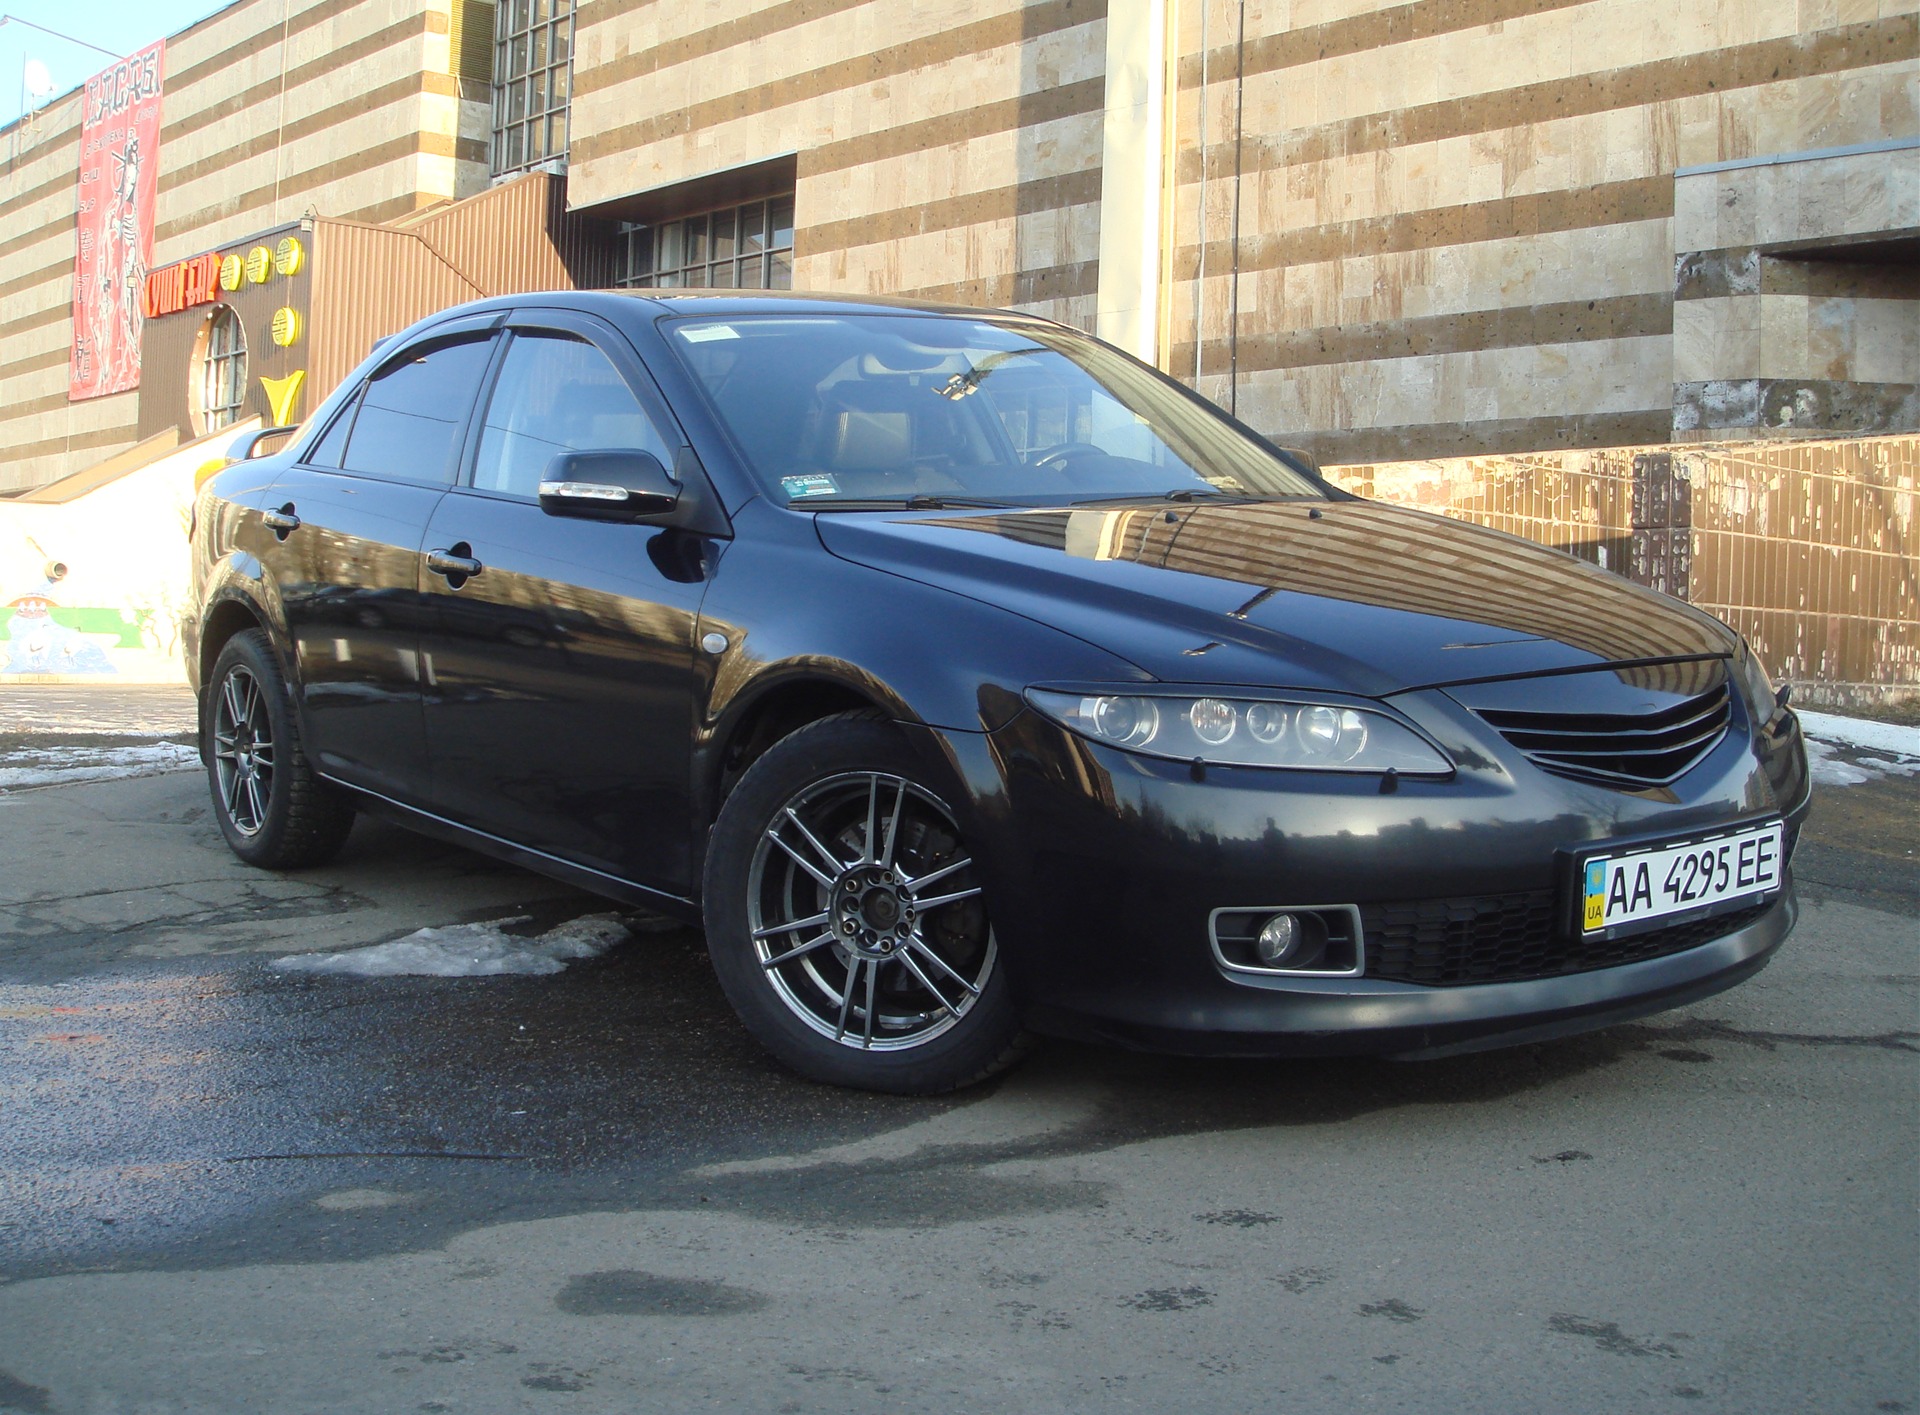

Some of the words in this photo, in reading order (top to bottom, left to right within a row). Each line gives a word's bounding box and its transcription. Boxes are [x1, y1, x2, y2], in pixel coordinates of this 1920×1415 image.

[1605, 862, 1652, 918] AA
[1663, 845, 1730, 903] 4295
[1736, 834, 1774, 888] EE
[1587, 906, 1602, 920] UA
